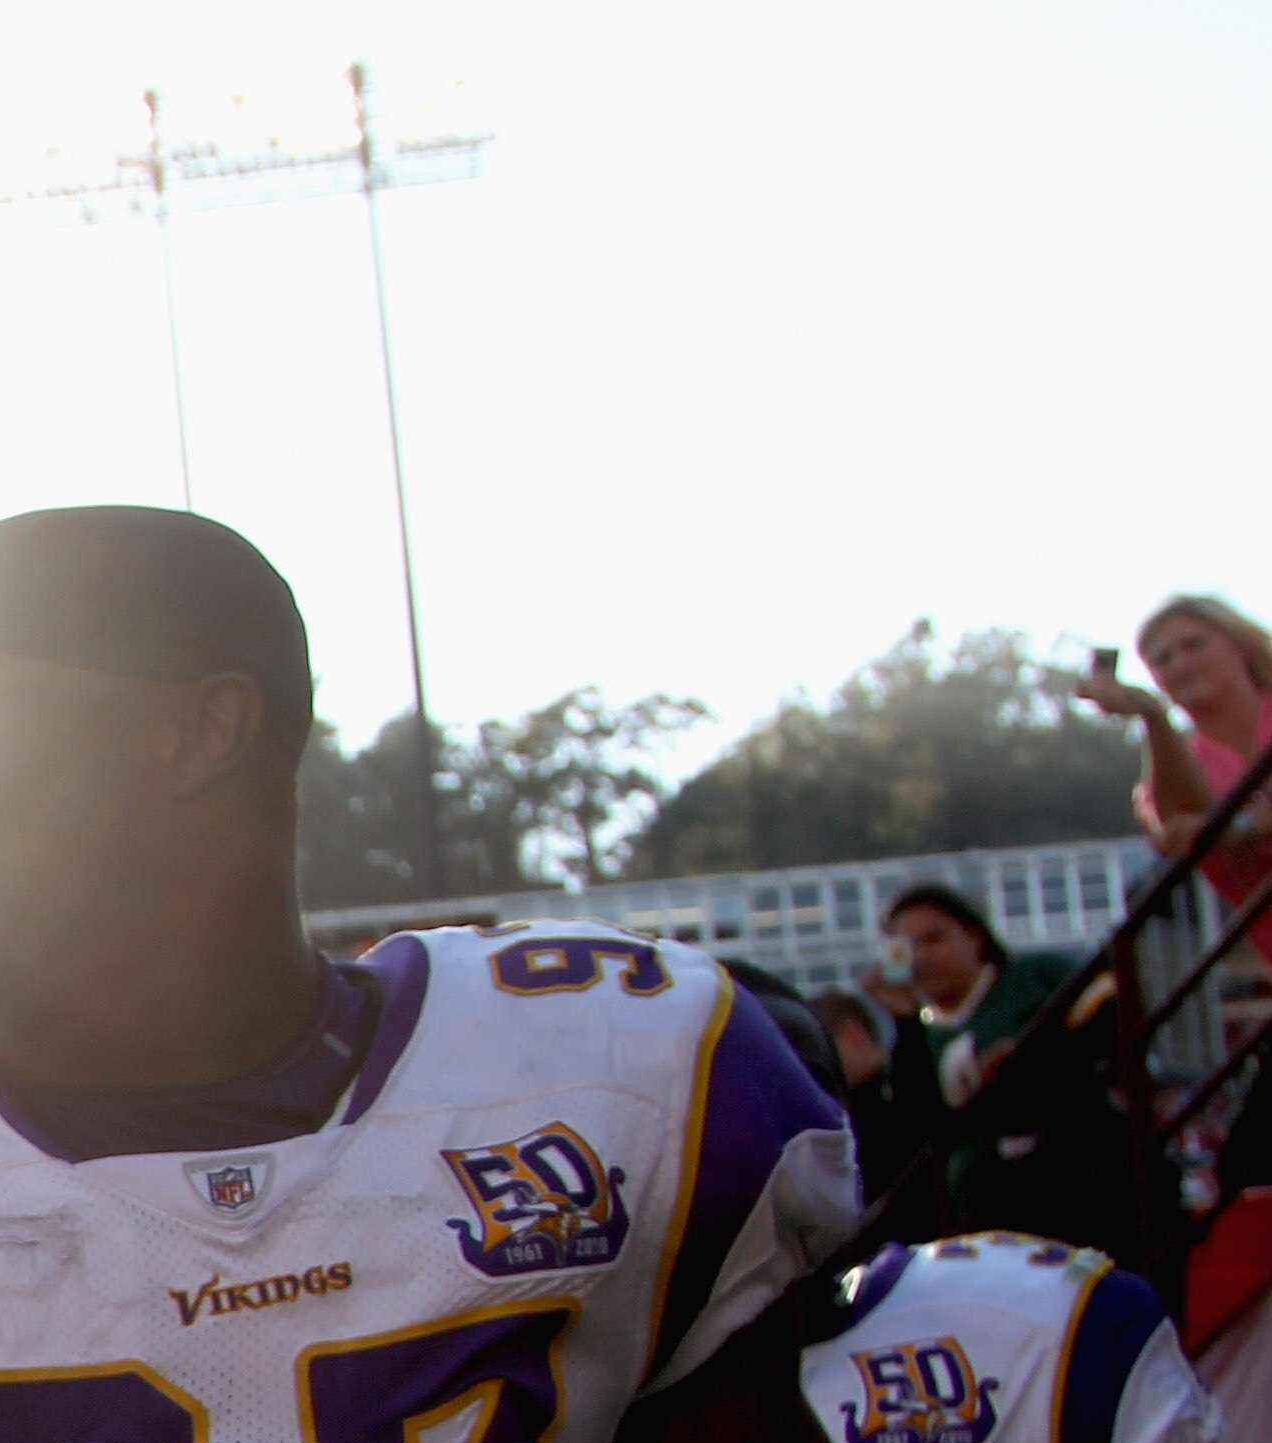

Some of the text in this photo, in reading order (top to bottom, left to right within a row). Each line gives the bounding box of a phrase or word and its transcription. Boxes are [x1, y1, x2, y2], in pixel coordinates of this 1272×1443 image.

[472, 920, 674, 997] 9
[461, 1133, 600, 1223] 50
[506, 1242, 545, 1265] 1961
[867, 1347, 965, 1412] 50
